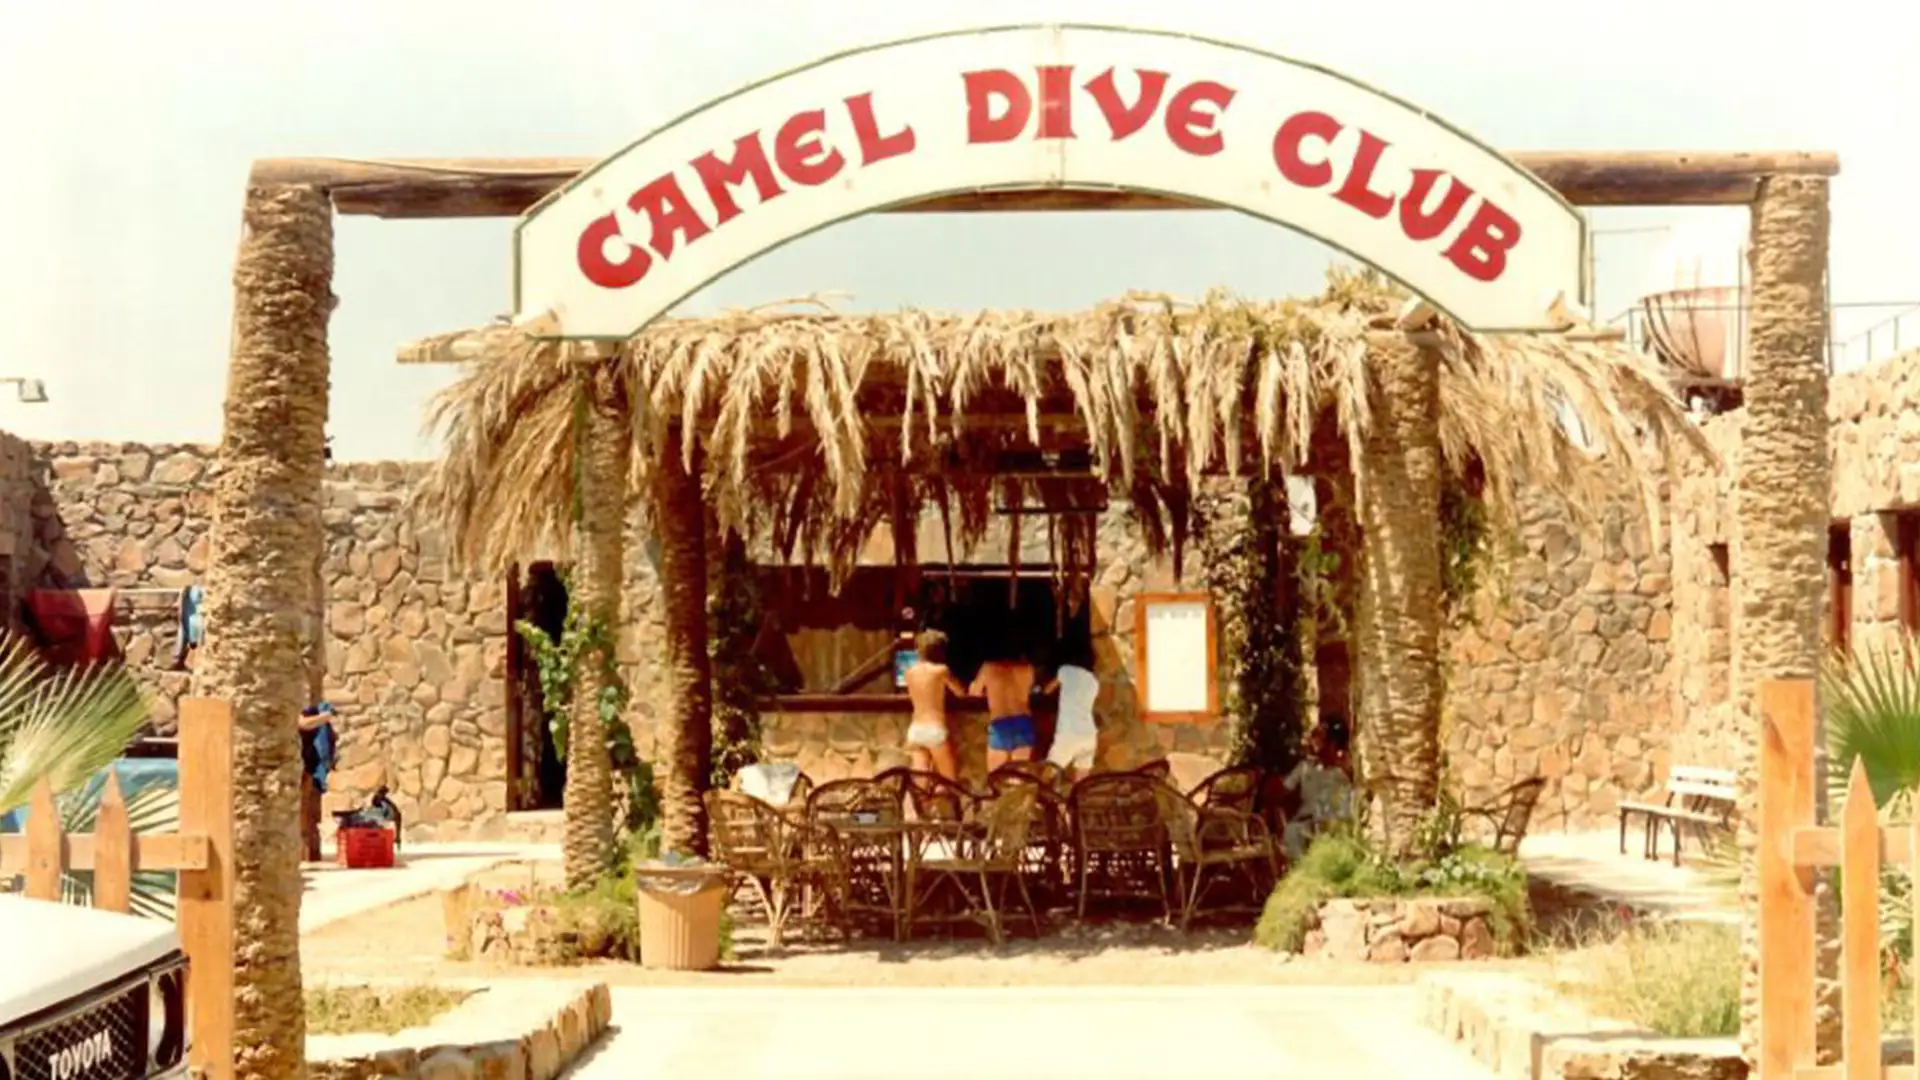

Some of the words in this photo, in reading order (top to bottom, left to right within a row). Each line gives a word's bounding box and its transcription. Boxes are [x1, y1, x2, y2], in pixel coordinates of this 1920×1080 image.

[577, 92, 916, 289] CAMEL
[962, 65, 1237, 155] DIVE
[1273, 111, 1521, 283] CLUB
[49, 1029, 112, 1080] TOYOTA
